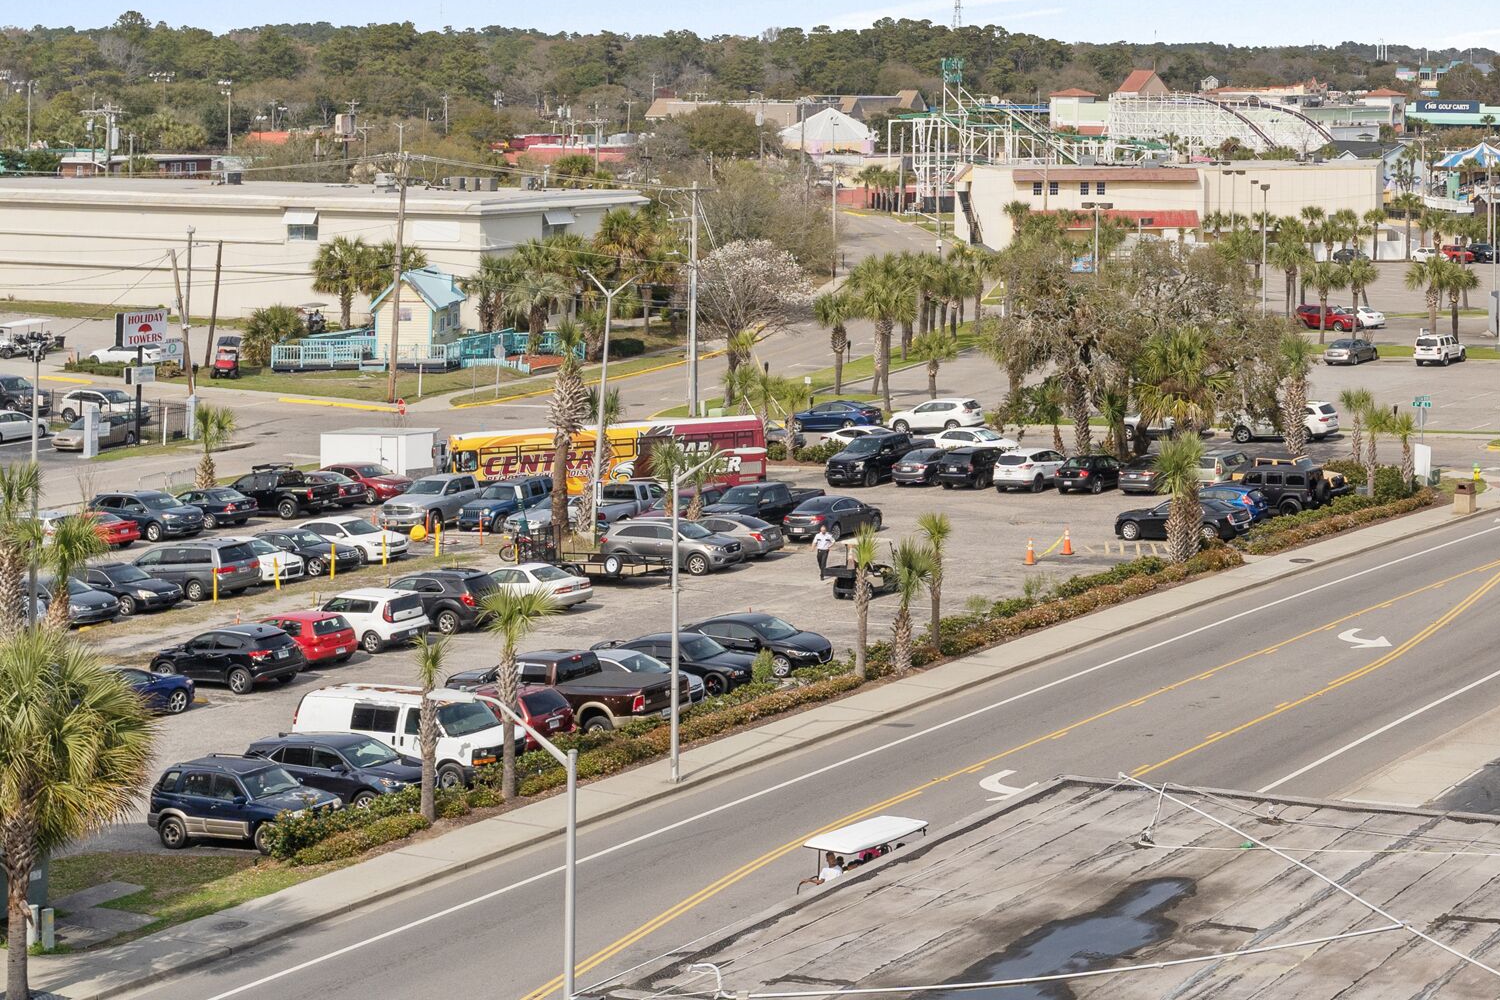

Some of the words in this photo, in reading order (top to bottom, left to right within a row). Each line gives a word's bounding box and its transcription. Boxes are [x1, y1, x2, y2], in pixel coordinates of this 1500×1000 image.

[128, 312, 164, 325] HOLIDAY
[128, 332, 163, 345] TOWERS
[484, 451, 597, 476] CENTRA
